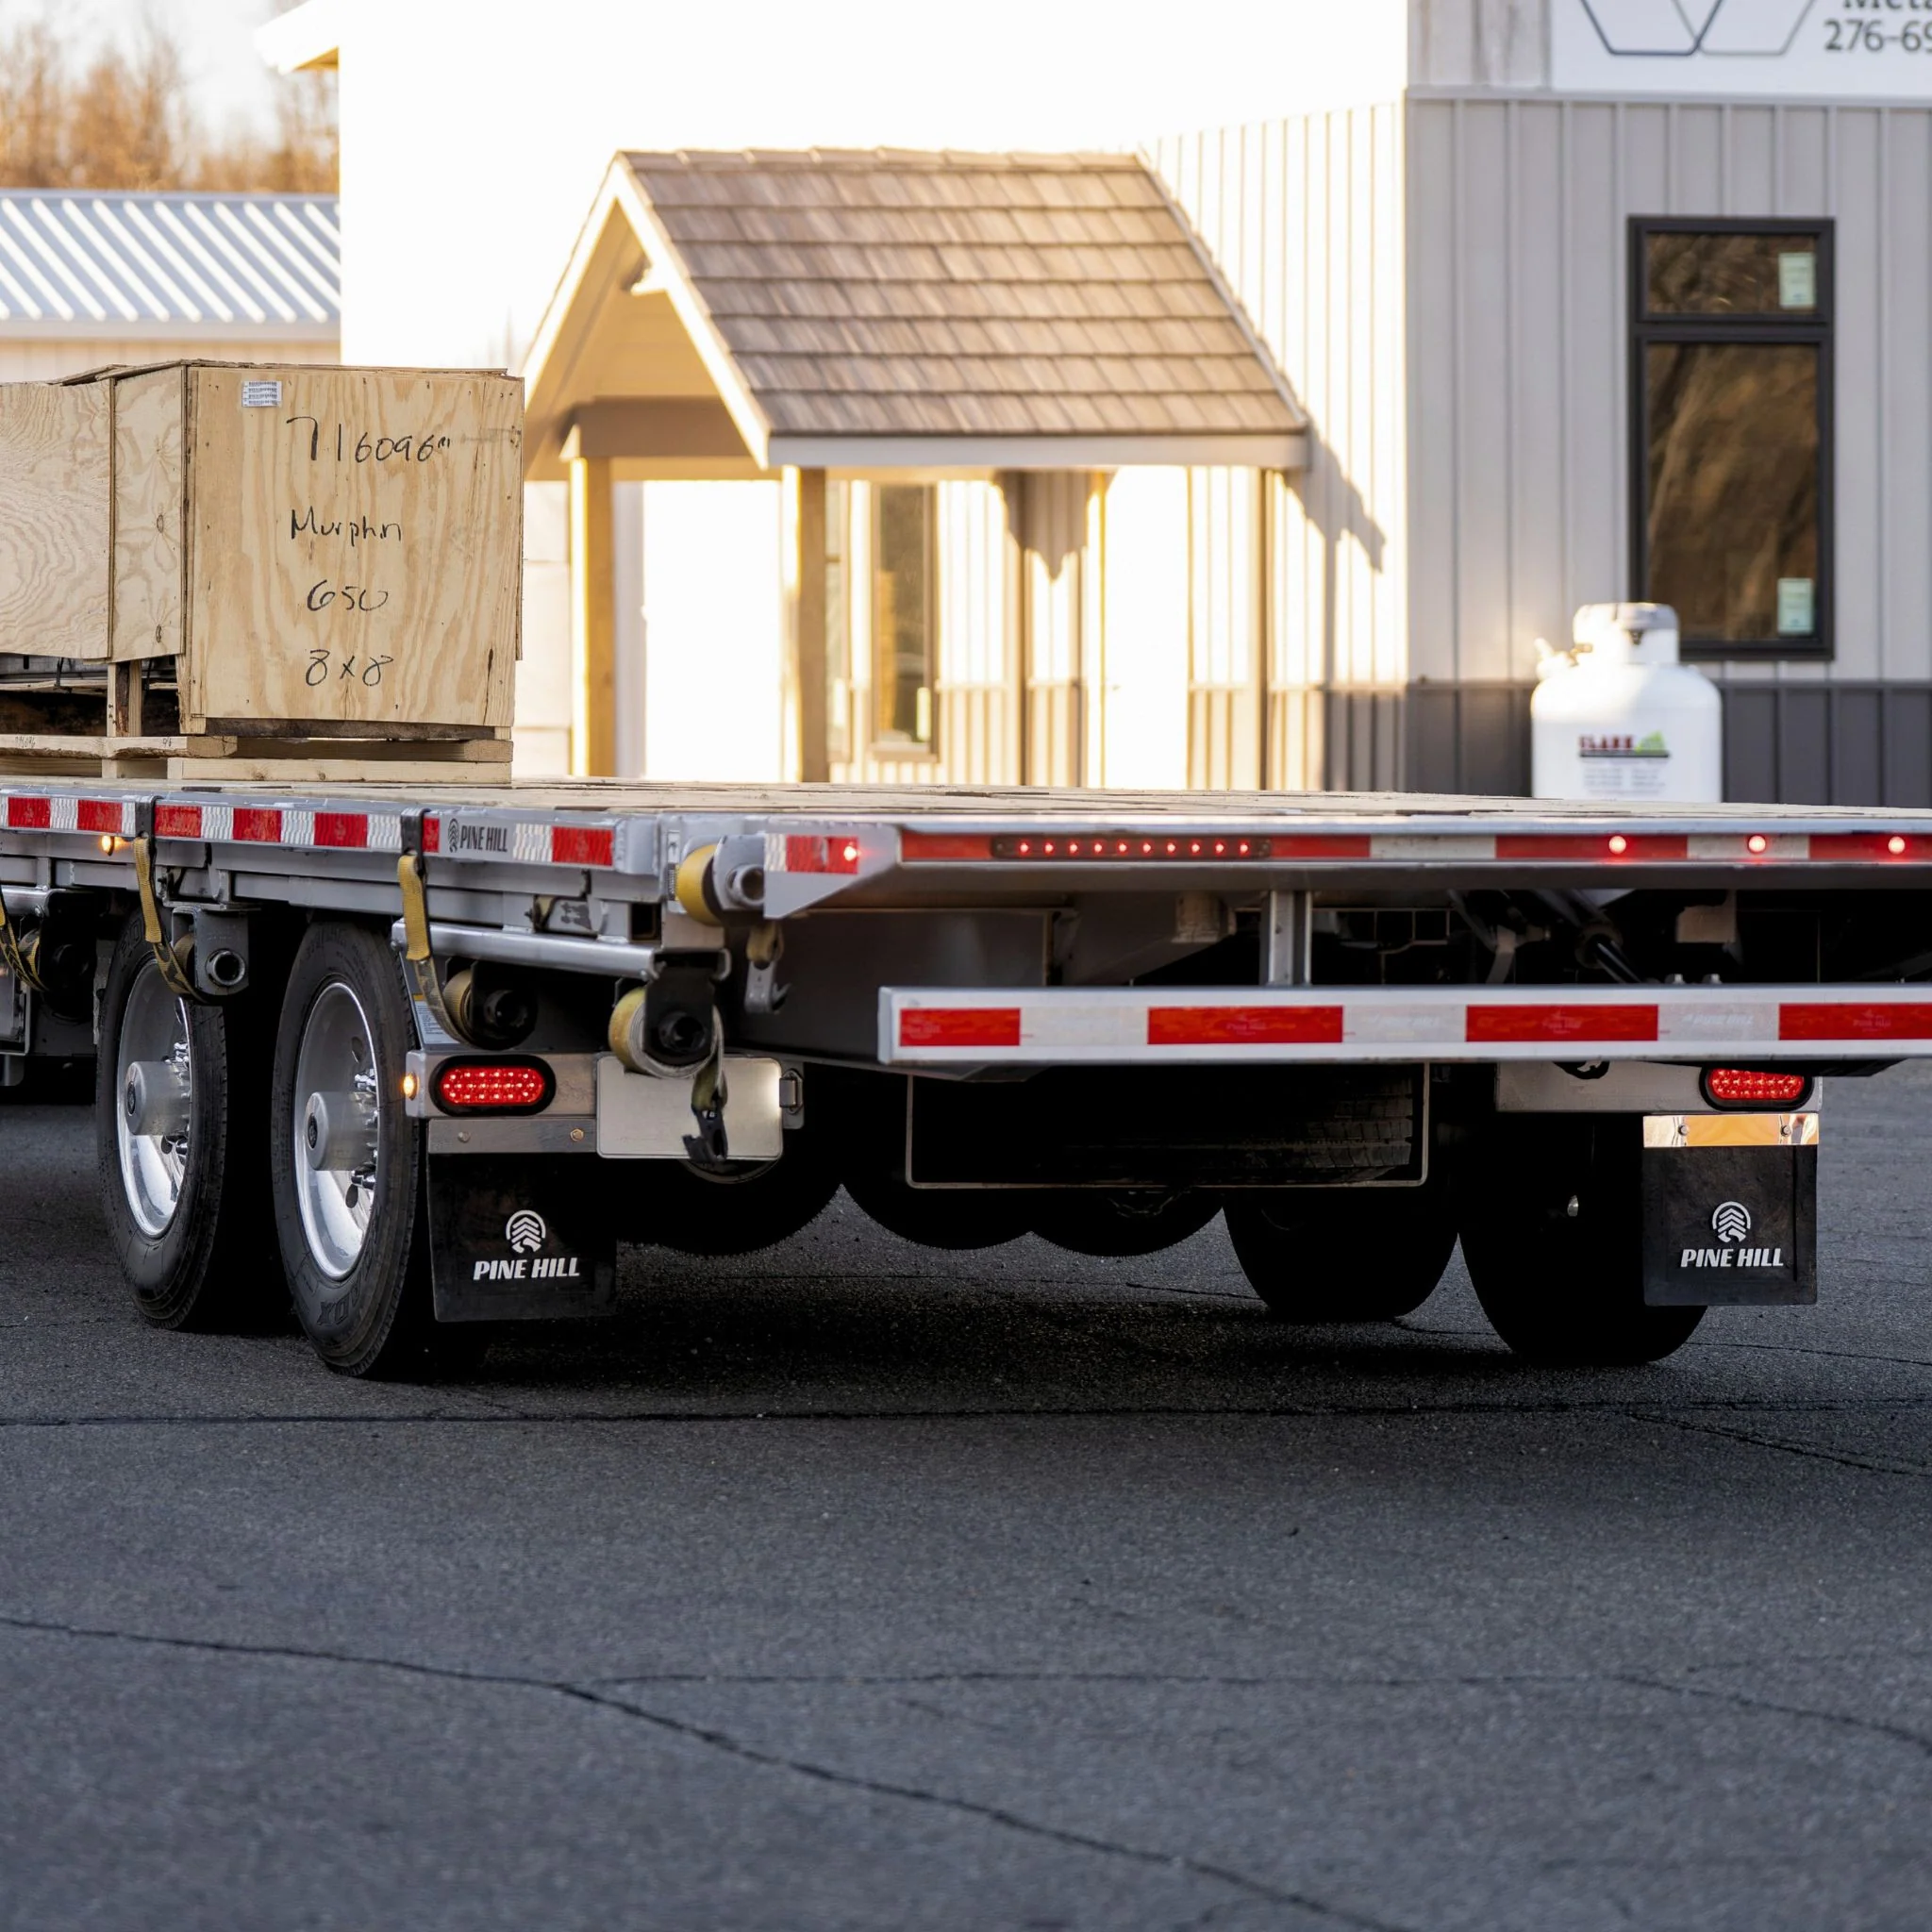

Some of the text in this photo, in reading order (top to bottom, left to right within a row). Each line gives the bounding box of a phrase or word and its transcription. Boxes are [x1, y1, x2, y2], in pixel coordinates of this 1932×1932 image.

[307, 579, 389, 611] 650
[459, 824, 508, 852] PINE HILL
[473, 1257, 580, 1280] PINE HILL
[1680, 1247, 1784, 1267] PINE HILL
